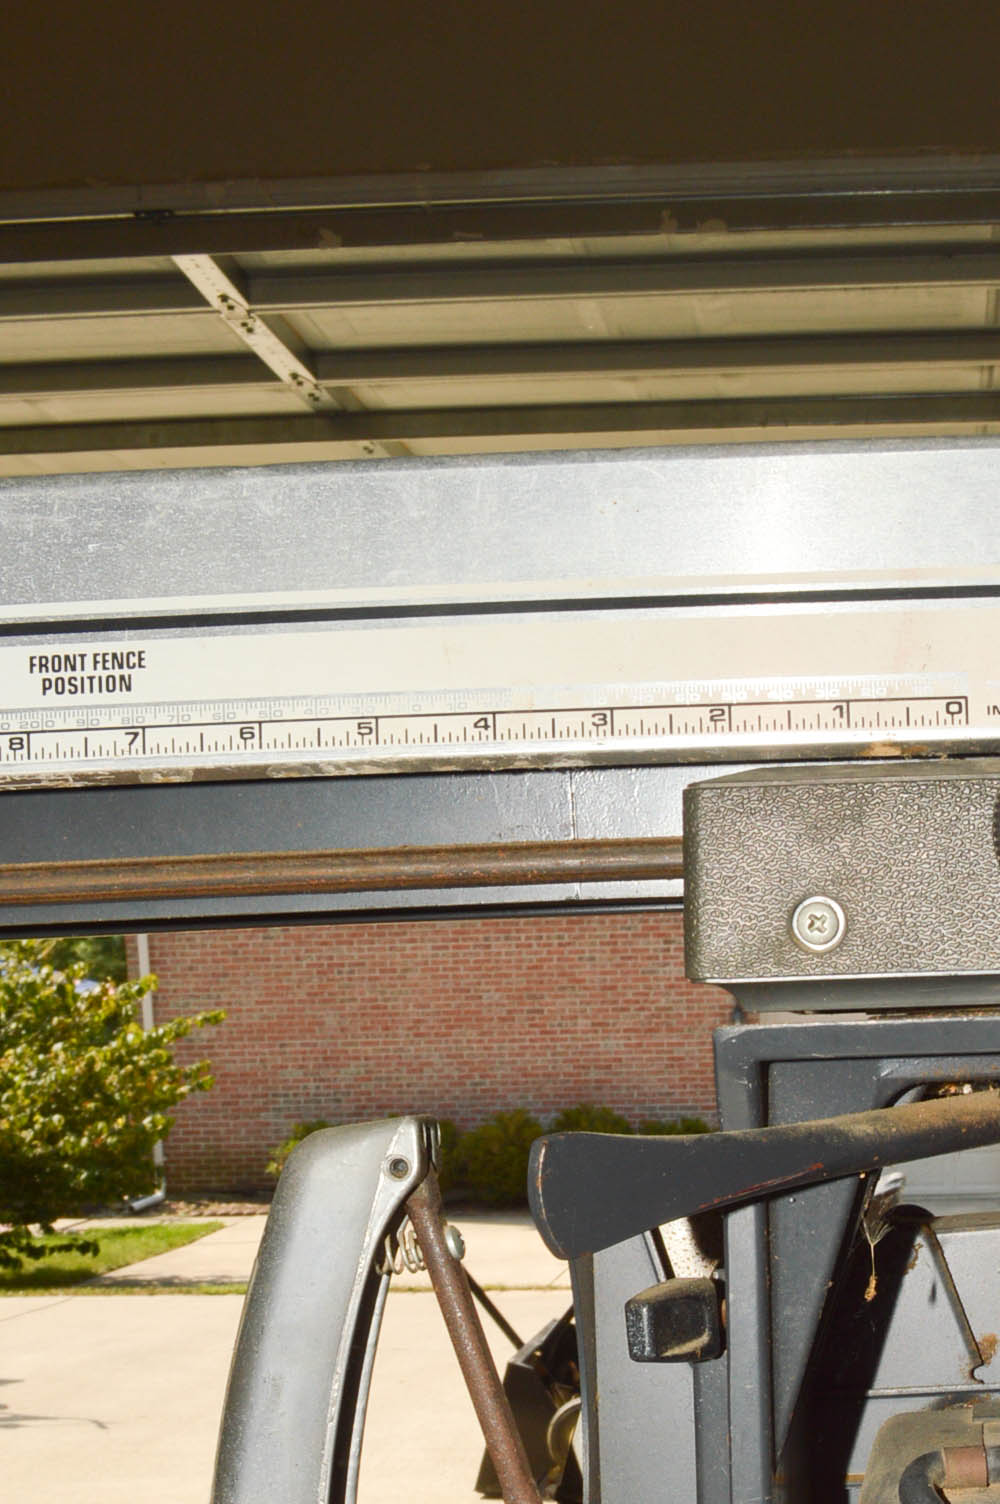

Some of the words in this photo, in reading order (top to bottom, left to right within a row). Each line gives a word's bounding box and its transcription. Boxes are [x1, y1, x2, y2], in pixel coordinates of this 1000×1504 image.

[28, 653, 87, 674] FRONT
[92, 650, 147, 671] FENCE
[42, 674, 133, 696] POSITION
[8, 737, 25, 751] 8
[124, 731, 140, 747] 7
[239, 726, 256, 741] 6
[356, 721, 373, 736] 5
[473, 717, 491, 732] 4
[591, 712, 608, 727] 3
[708, 708, 726, 722] 2
[833, 704, 844, 719] 1
[945, 701, 963, 716] 0
